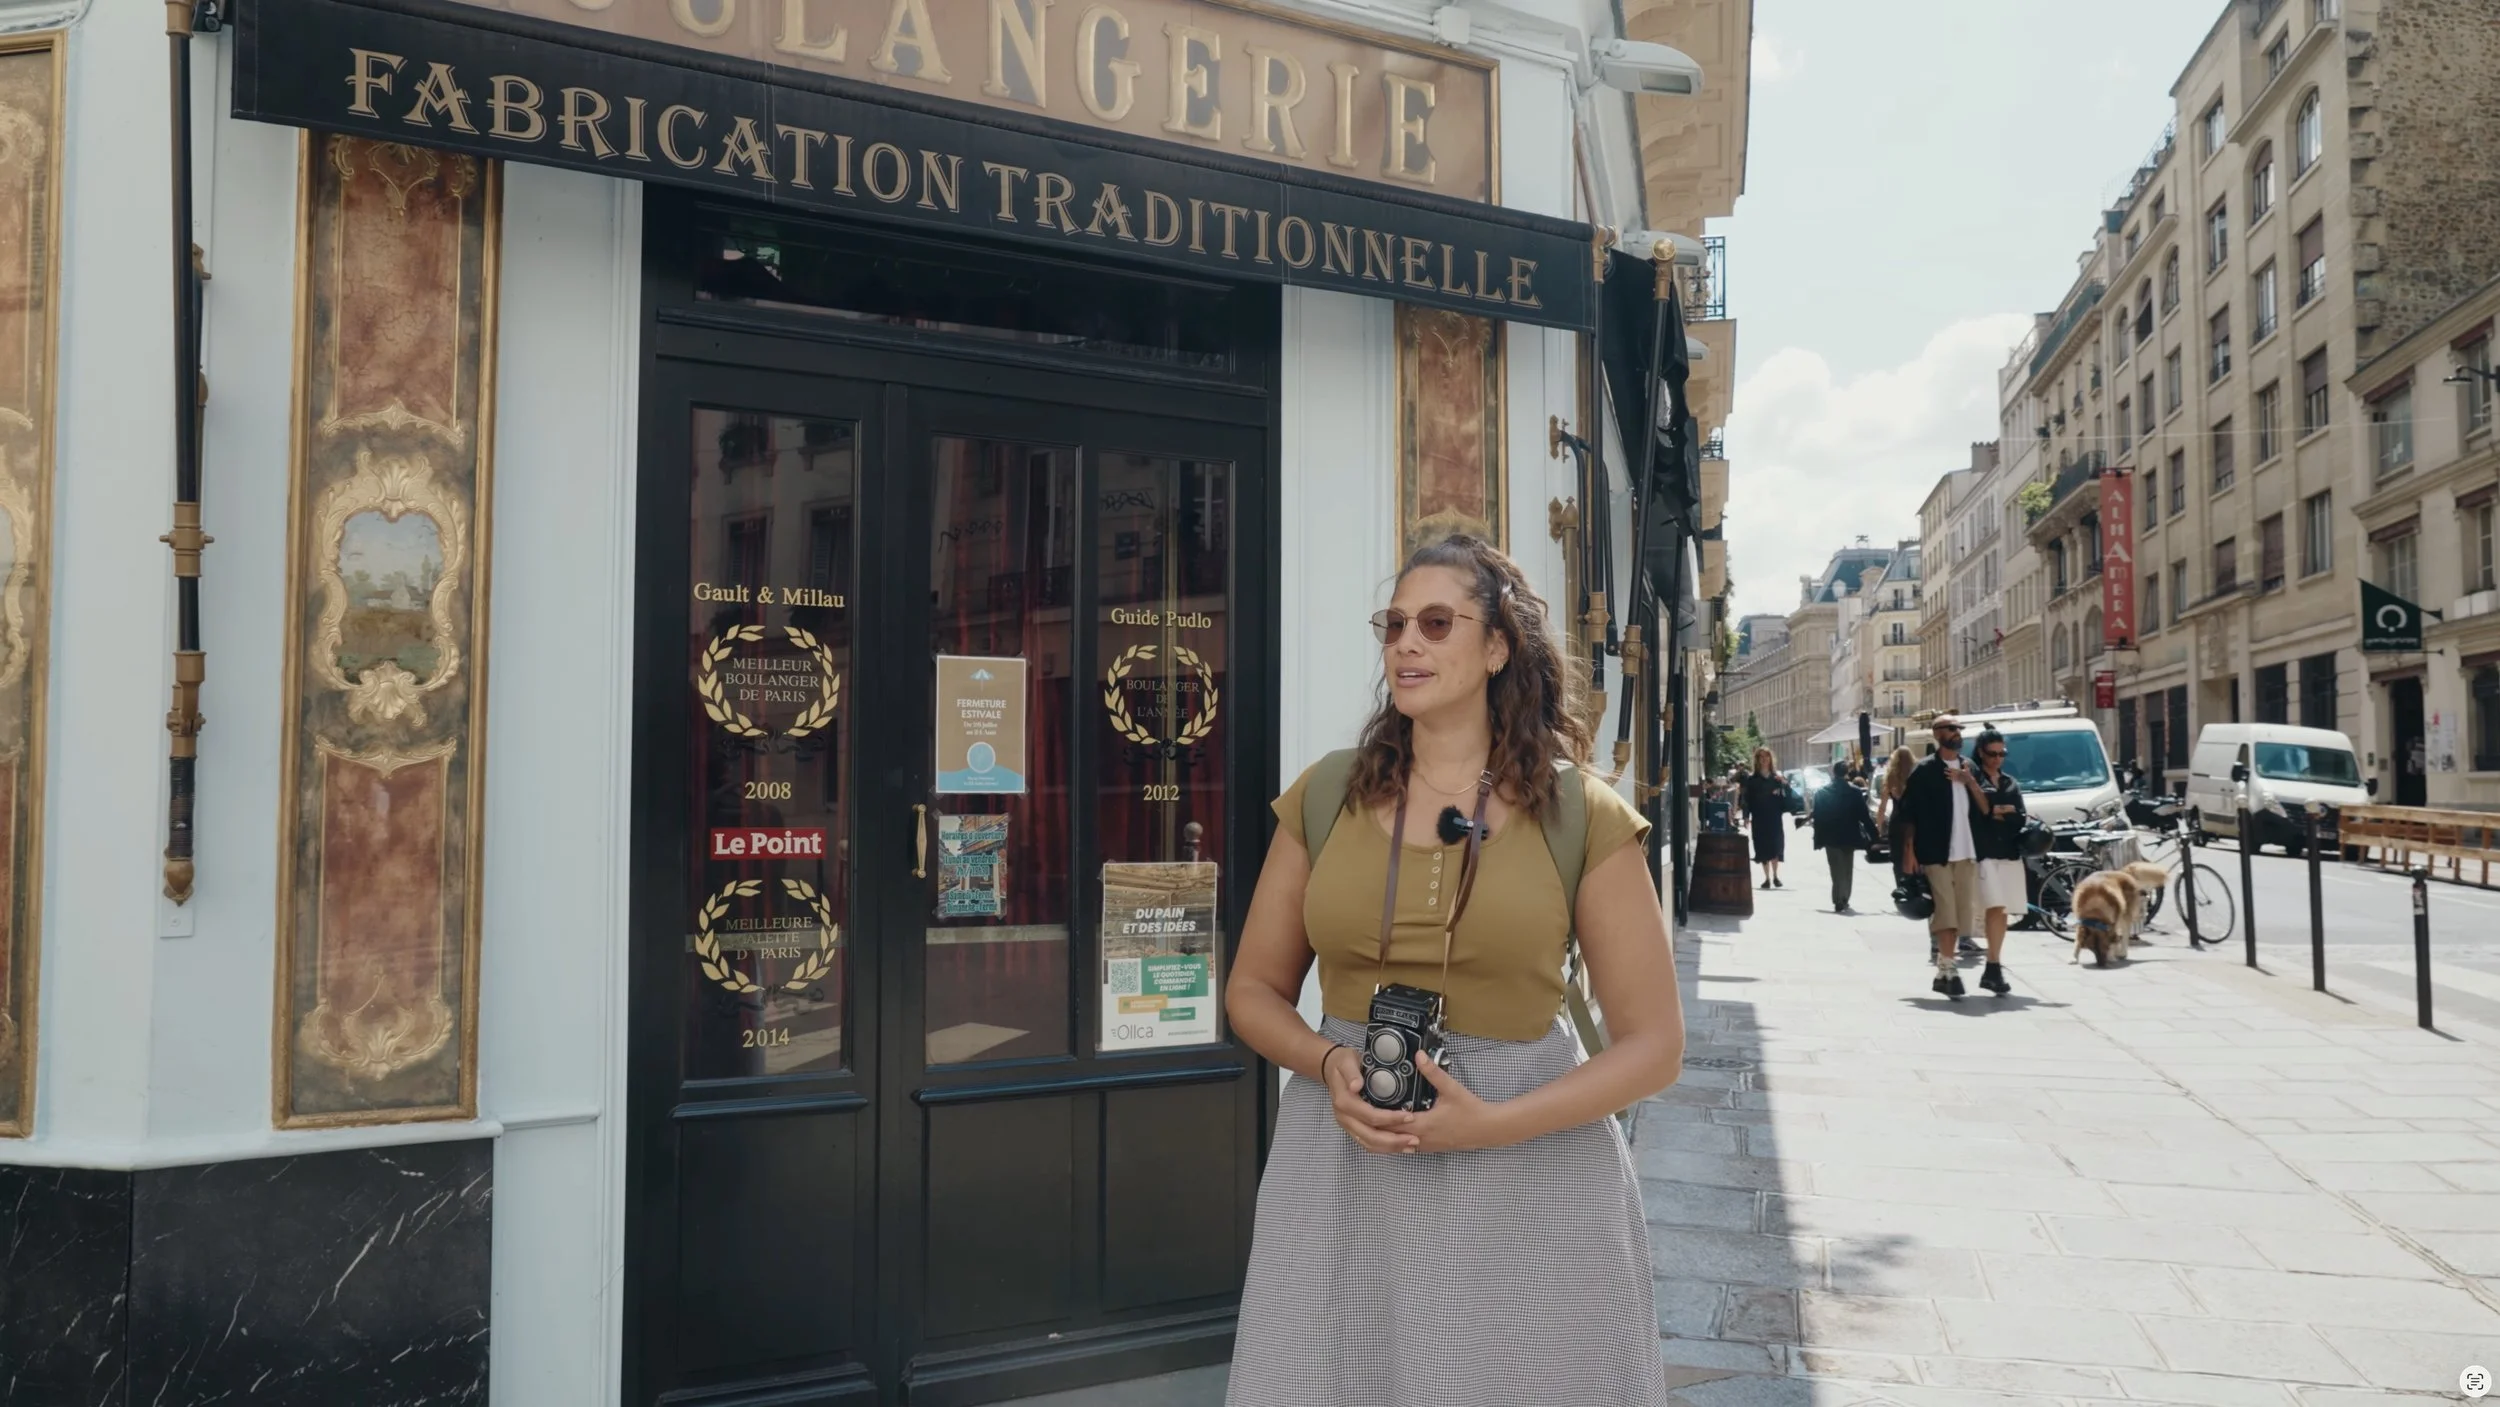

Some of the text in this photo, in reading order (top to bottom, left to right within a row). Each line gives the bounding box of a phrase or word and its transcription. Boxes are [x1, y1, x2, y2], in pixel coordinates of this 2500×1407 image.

[568, 0, 1437, 185] LANGERIE
[344, 47, 1544, 309] FABRICATION TRADITIONNELLE
[693, 582, 846, 609] Gault & Millau
[1111, 607, 1212, 629] Guide Pudlo
[733, 657, 813, 673] MEILLEUR
[725, 673, 820, 688] BOULANGER
[739, 688, 807, 703] DE PARIS
[956, 698, 1007, 709] FERMETURE
[961, 709, 1002, 719] ESTIVALE
[744, 781, 792, 800] 2008
[1143, 784, 1181, 801] 2012
[714, 830, 823, 855] Le Point
[1135, 906, 1185, 920] DU PAIN
[725, 916, 813, 931] MEILLEURE
[1122, 918, 1197, 934] ET DES IDÉES
[760, 946, 802, 960] PARIS
[743, 1028, 790, 1048] 2014
